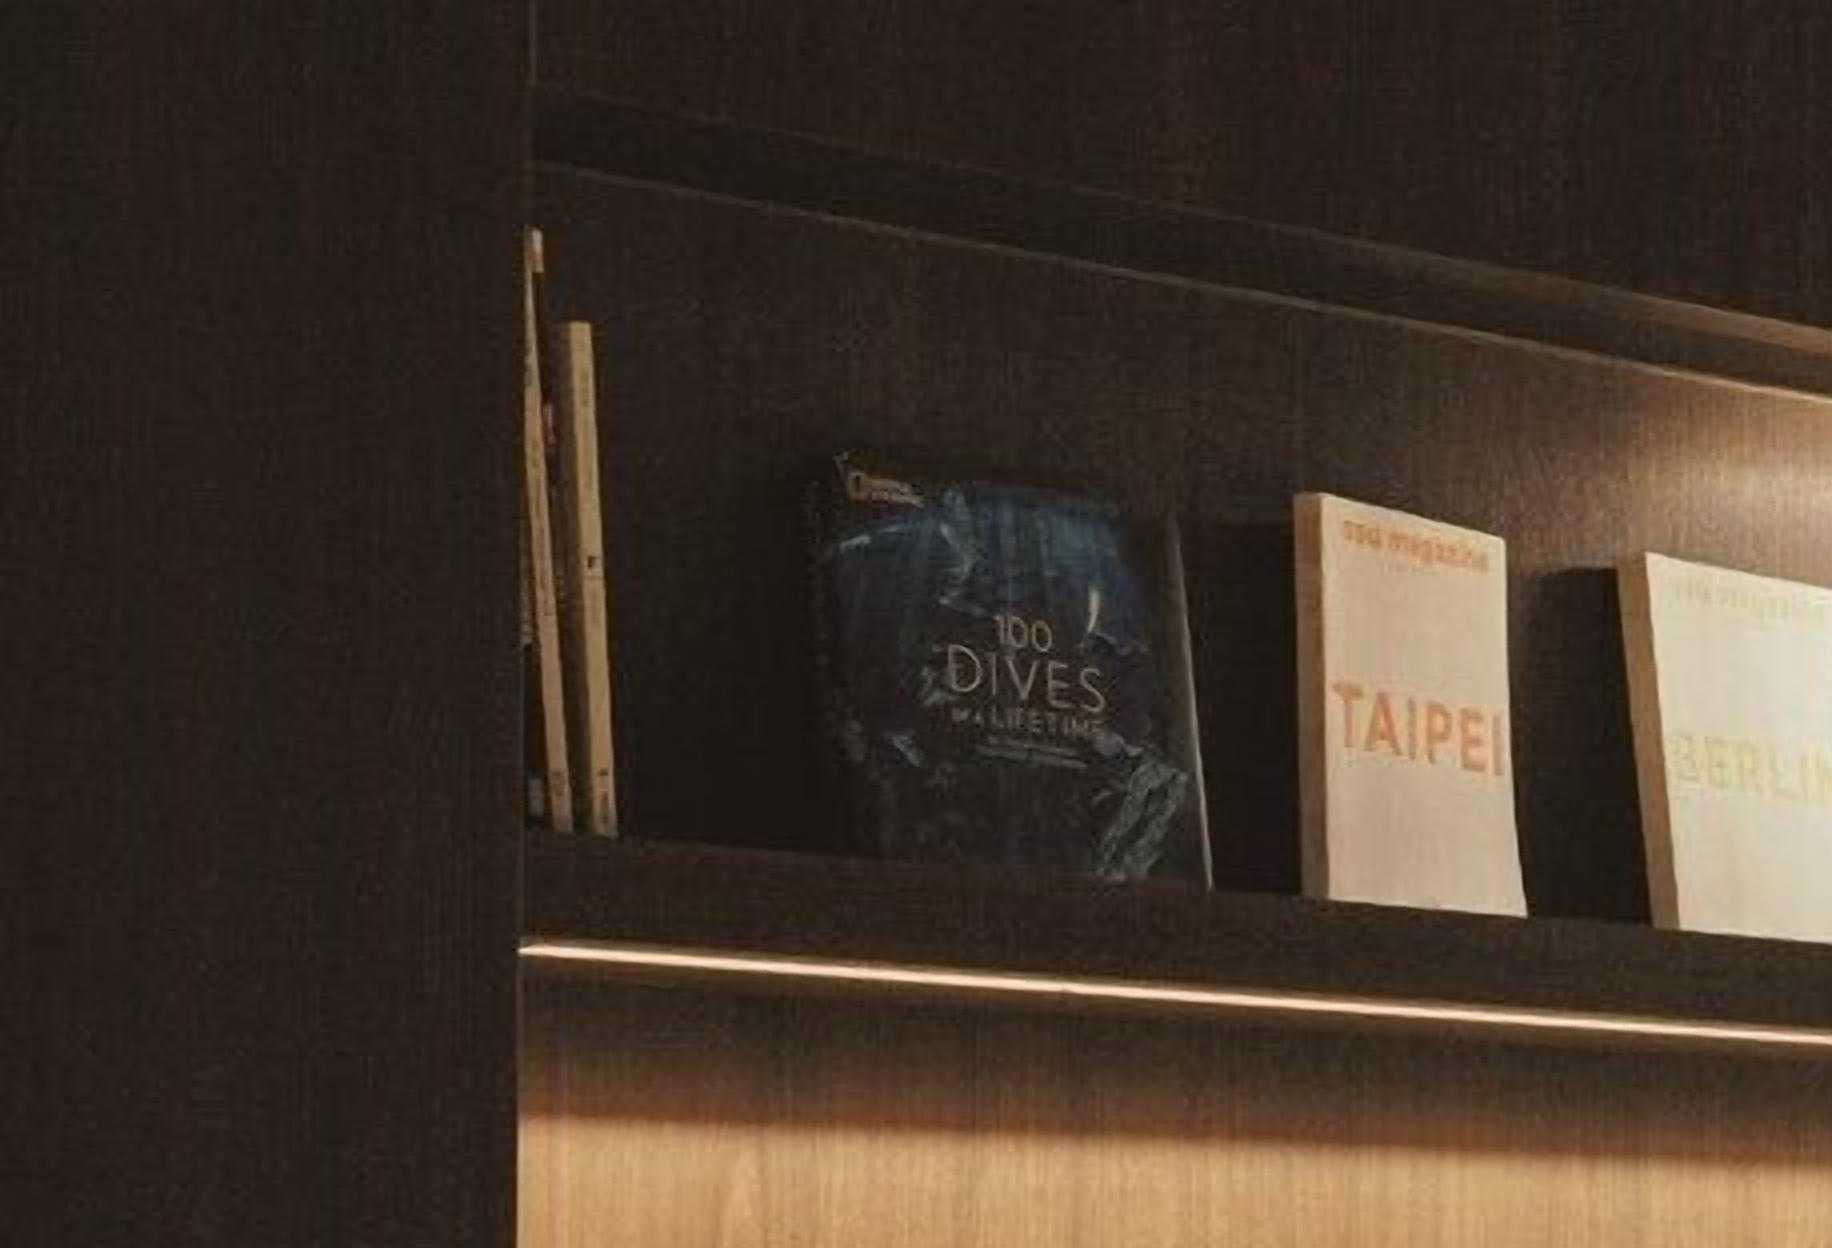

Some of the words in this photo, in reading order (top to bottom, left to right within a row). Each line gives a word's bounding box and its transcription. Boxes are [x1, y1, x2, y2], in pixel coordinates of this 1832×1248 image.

[994, 615, 1052, 652] 100
[948, 643, 1106, 712] DIVES
[1332, 682, 1506, 777] TAIPEI
